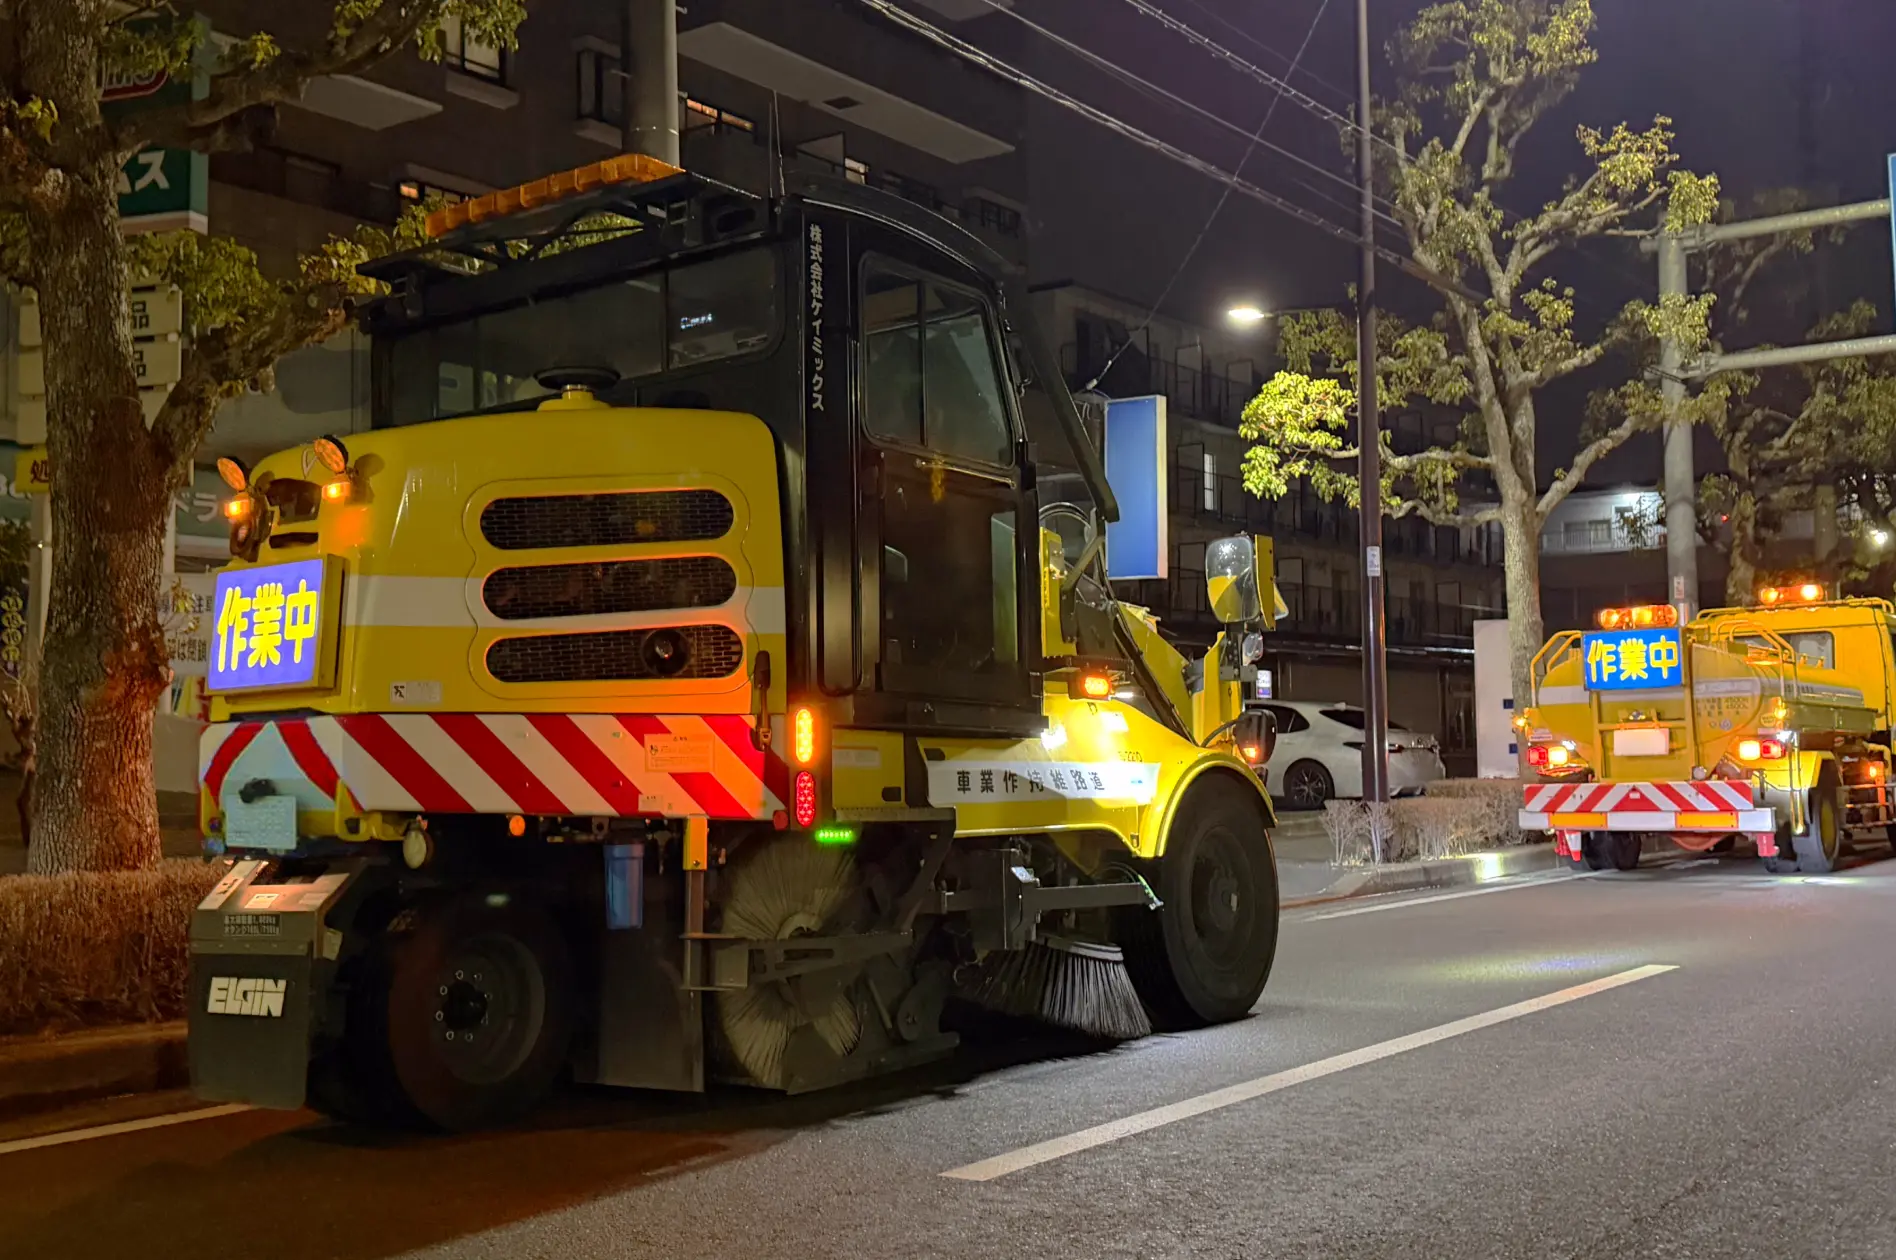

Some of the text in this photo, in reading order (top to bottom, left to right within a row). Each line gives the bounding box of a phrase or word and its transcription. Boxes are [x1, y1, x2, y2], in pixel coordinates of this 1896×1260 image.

[809, 223, 825, 412] 株式会社ケイミックス
[217, 579, 317, 673] 作業中
[1587, 635, 1679, 682] 作業中
[207, 976, 288, 1019] ELGIN
